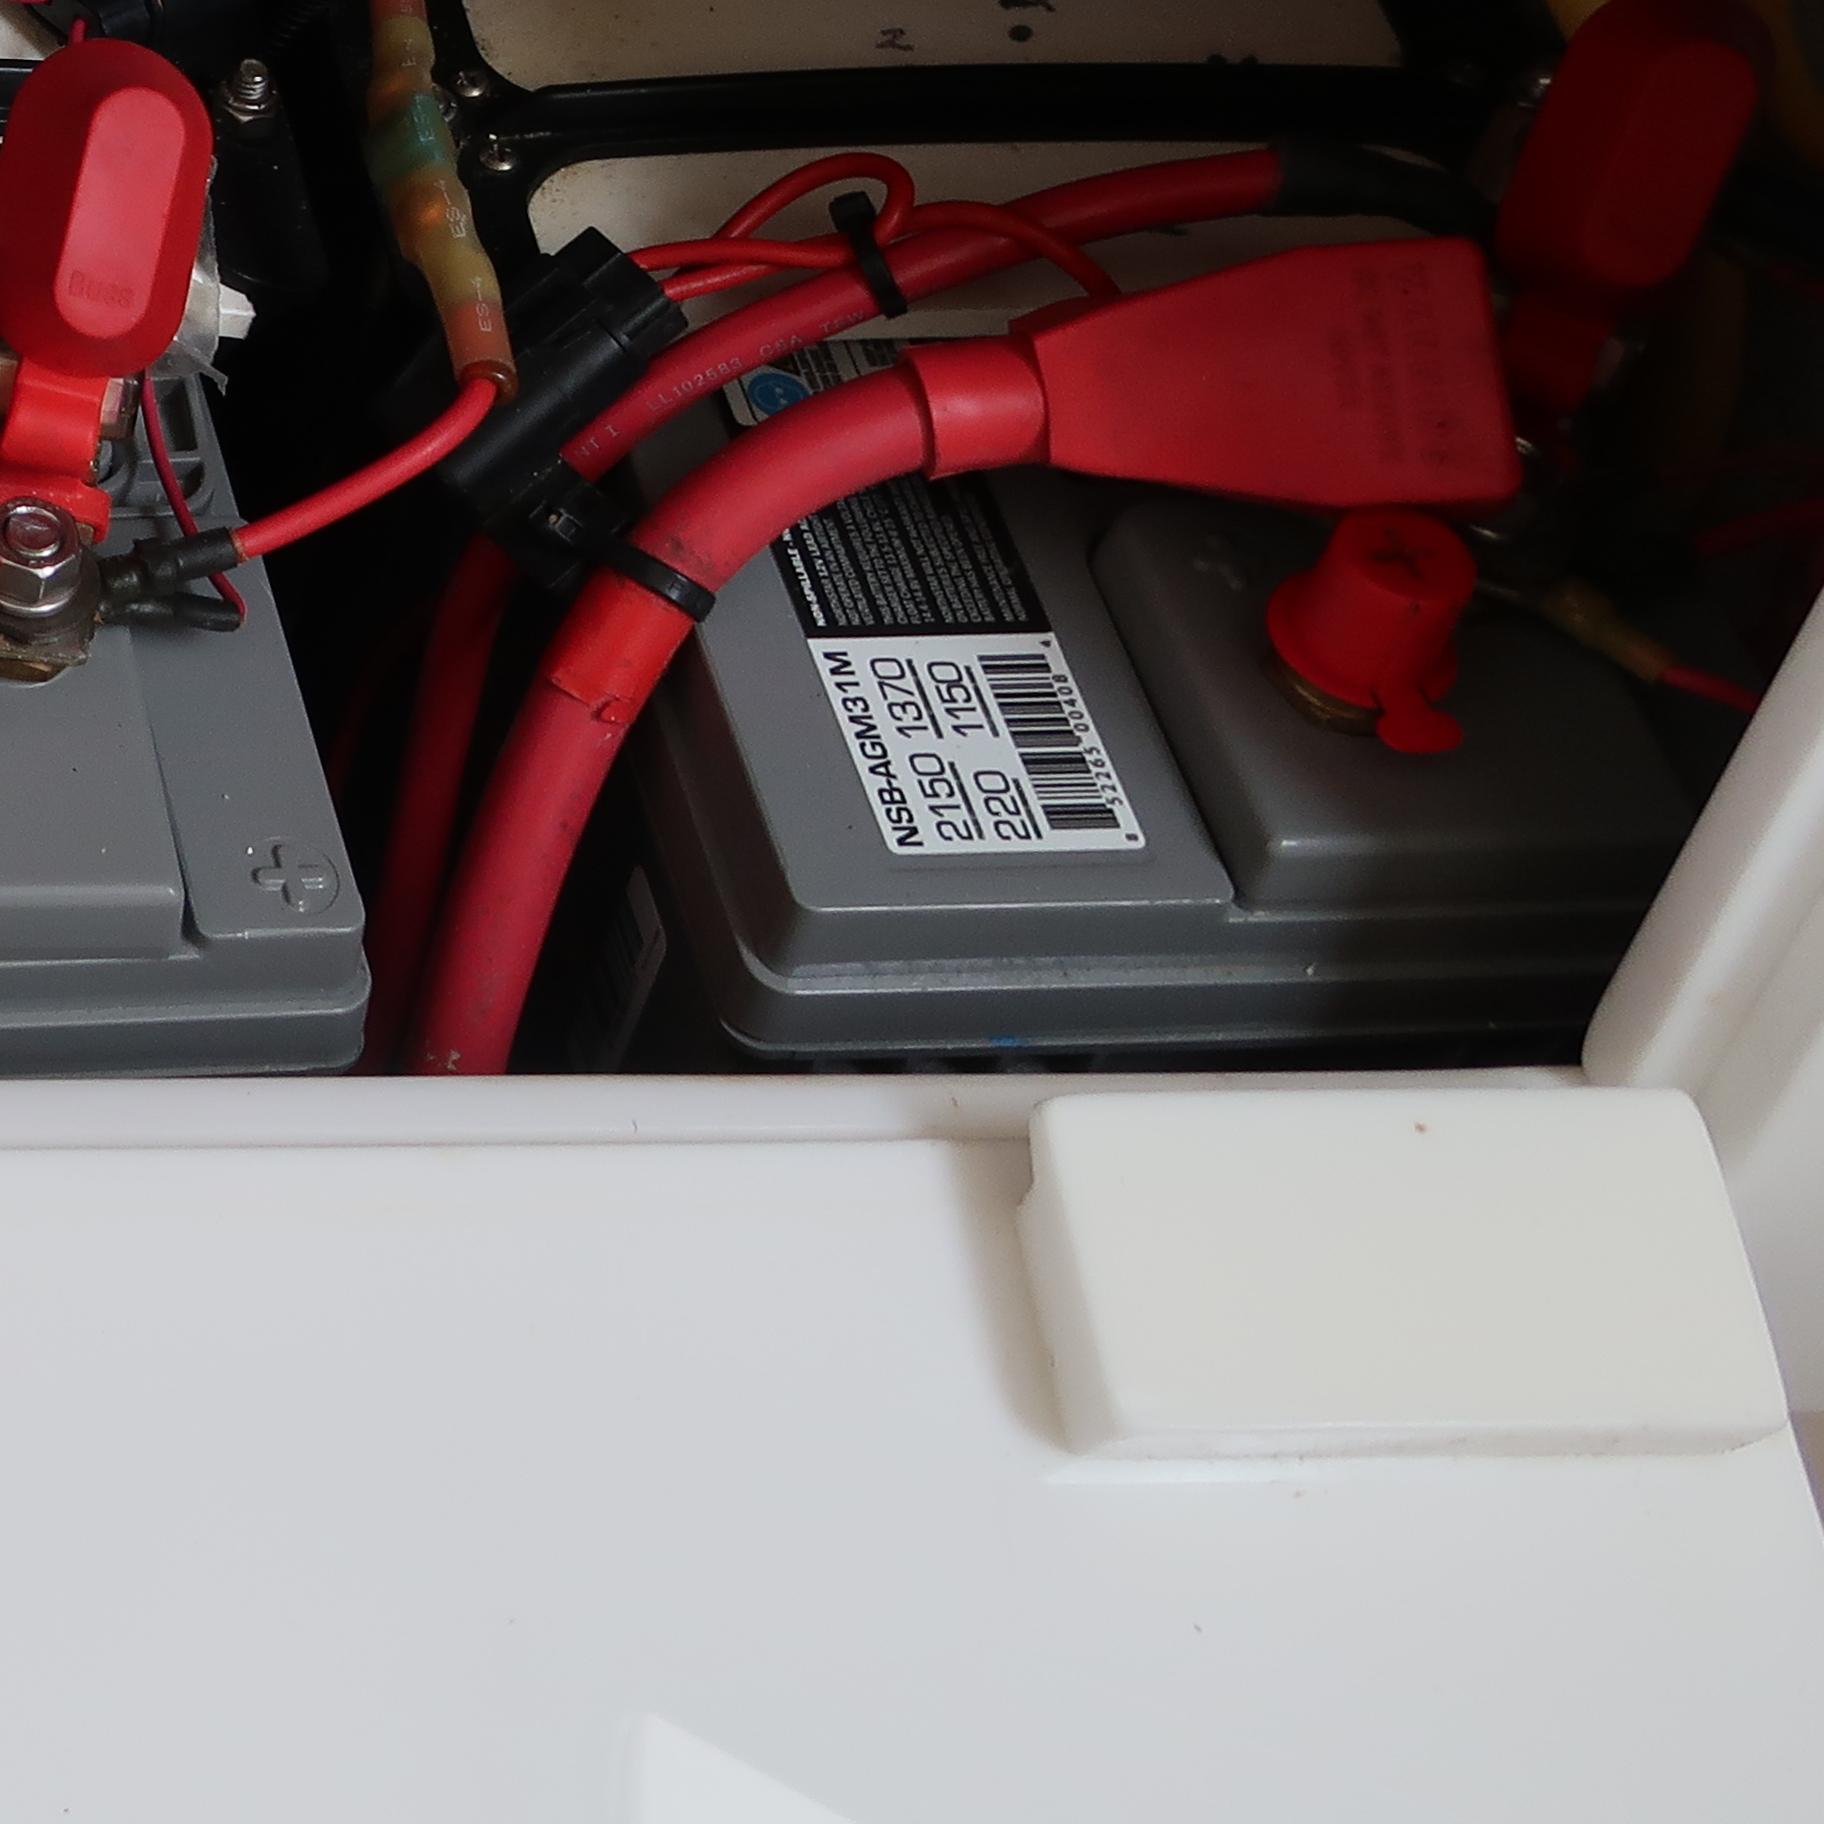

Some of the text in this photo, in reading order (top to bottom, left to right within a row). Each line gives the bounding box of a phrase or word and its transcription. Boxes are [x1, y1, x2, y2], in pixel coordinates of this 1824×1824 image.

[470, 276, 493, 333] ES-4
[759, 334, 803, 358] CSA
[1050, 673, 1090, 734] 00408
[822, 650, 924, 847] NSB-AGM31M
[869, 657, 974, 842] 2150 1370
[926, 660, 1031, 841] 220 1150
[1084, 746, 1123, 807] 52265
